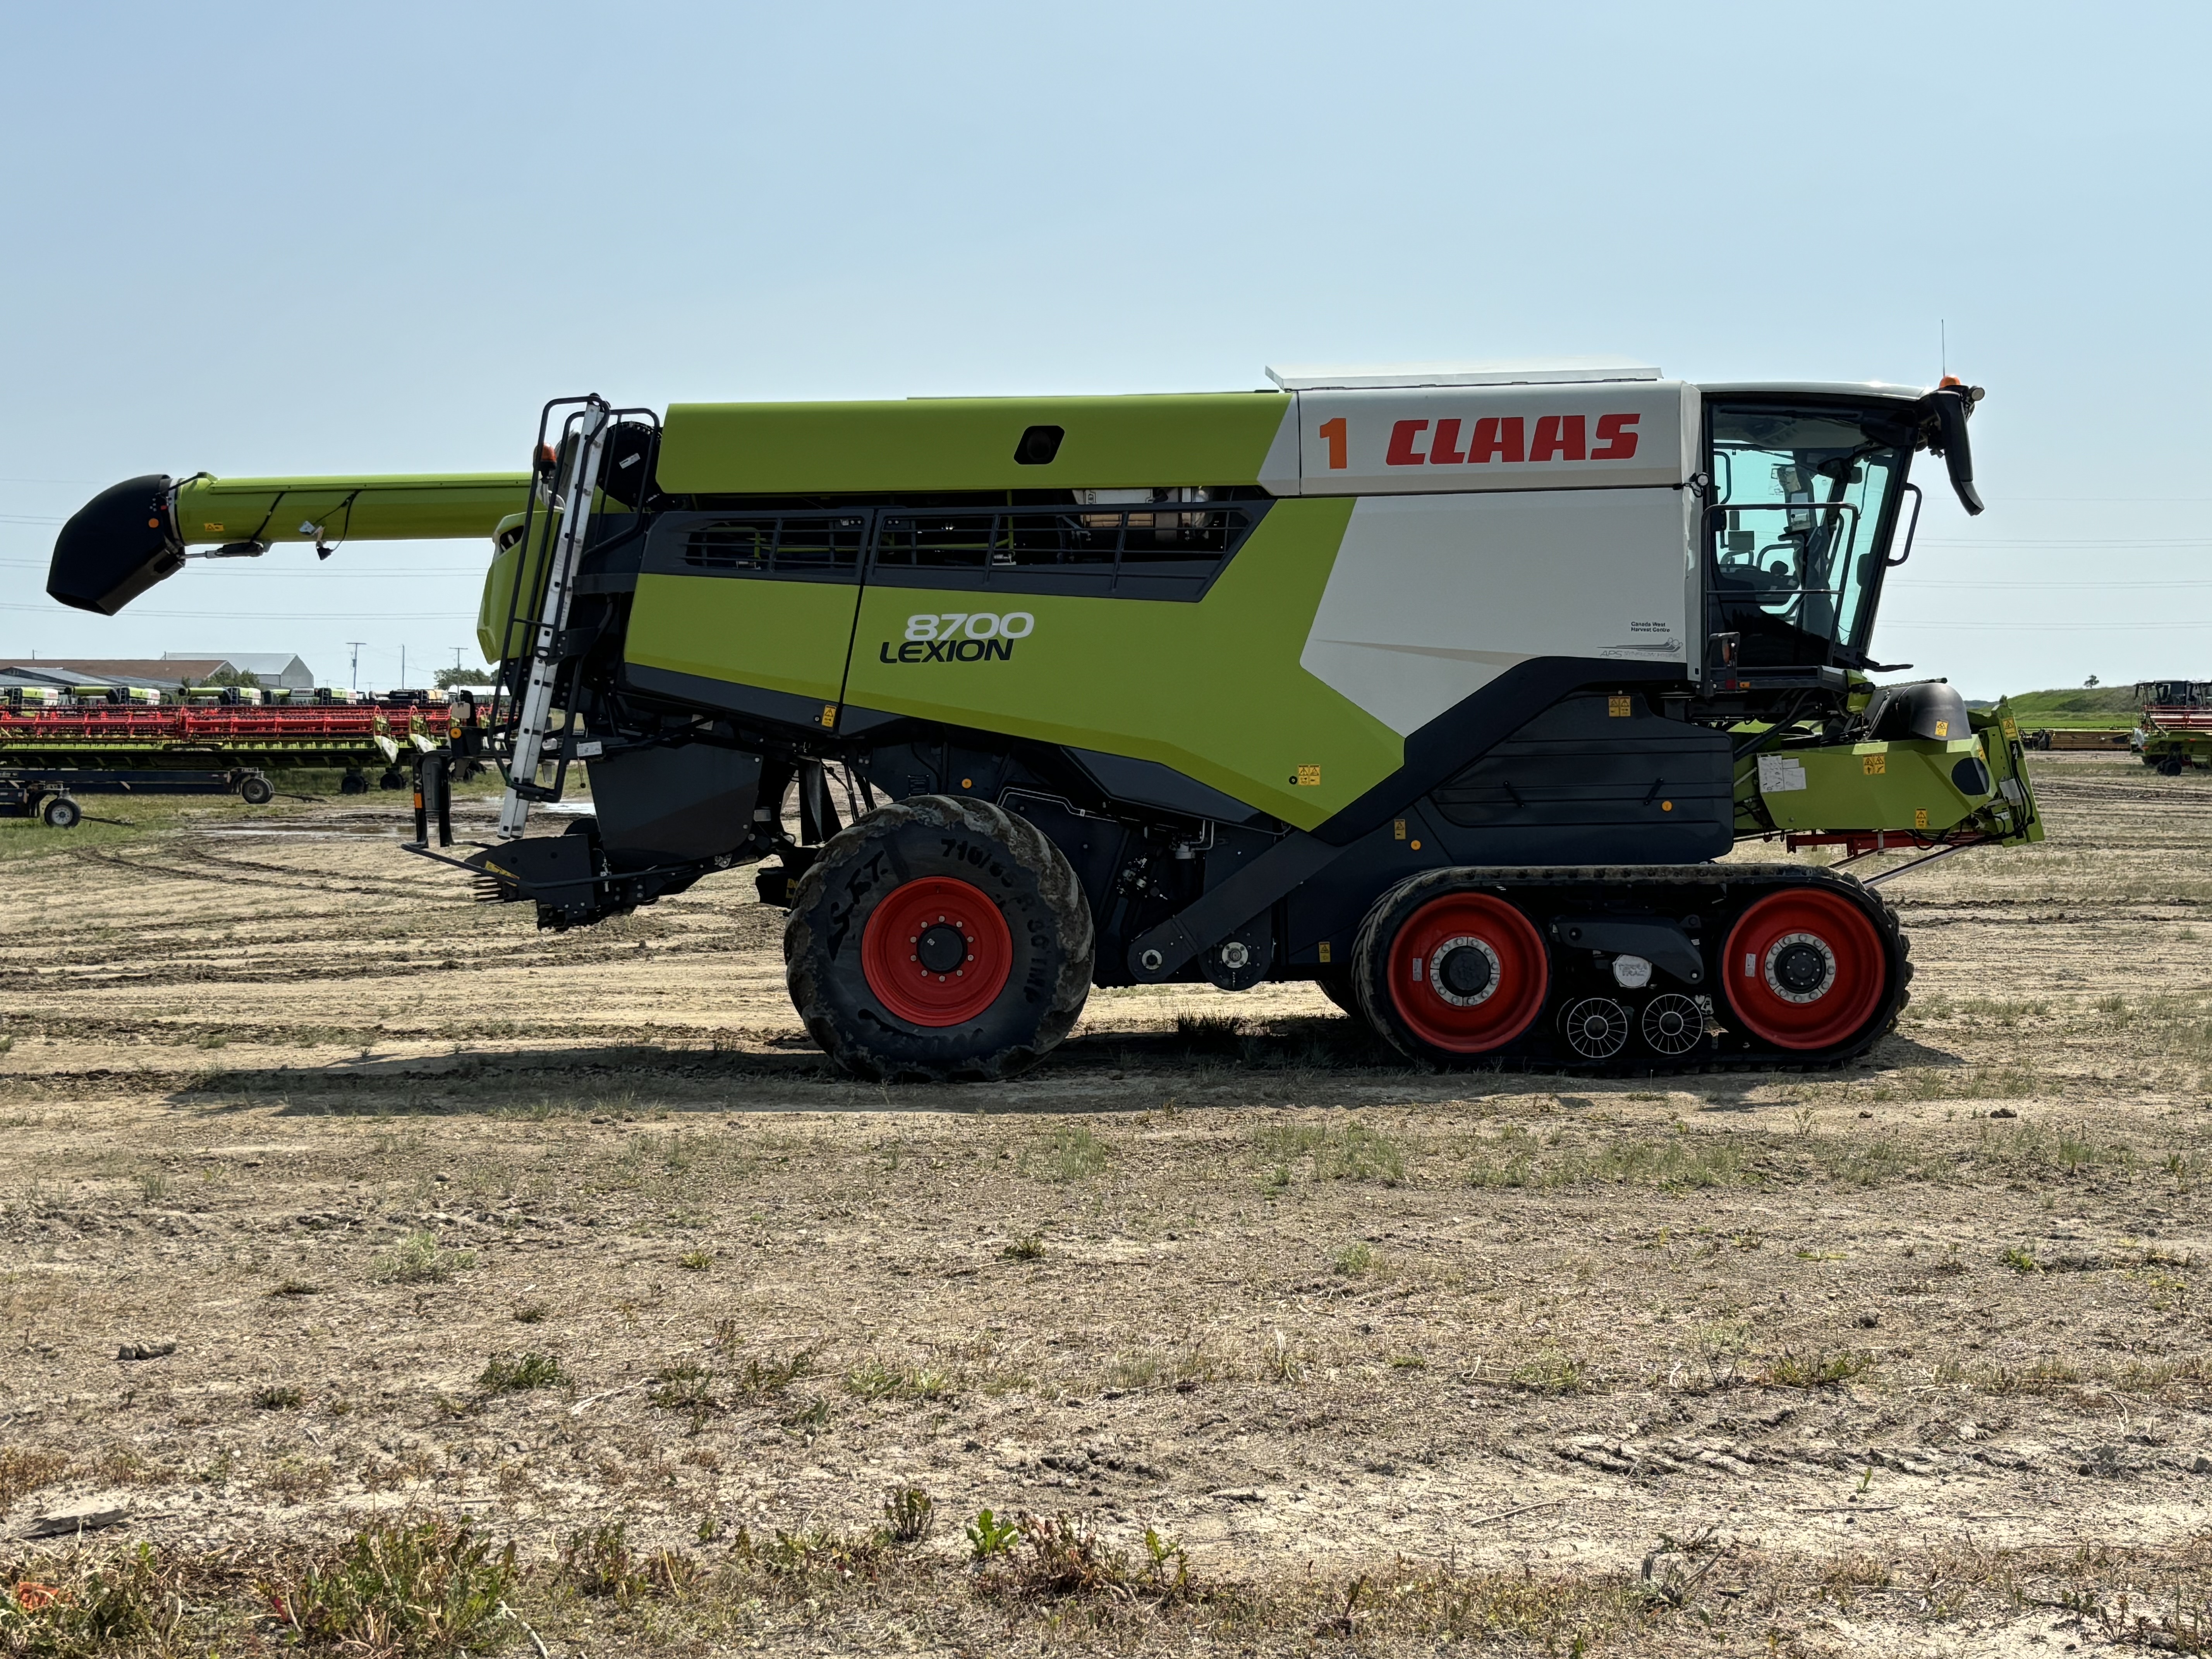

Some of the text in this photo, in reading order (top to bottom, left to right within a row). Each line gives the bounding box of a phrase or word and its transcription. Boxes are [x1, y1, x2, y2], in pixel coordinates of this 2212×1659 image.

[1319, 417, 1347, 469] 1
[1386, 414, 1640, 465] CLAAS
[904, 612, 1034, 641] 8700
[879, 639, 1014, 663] LEXION
